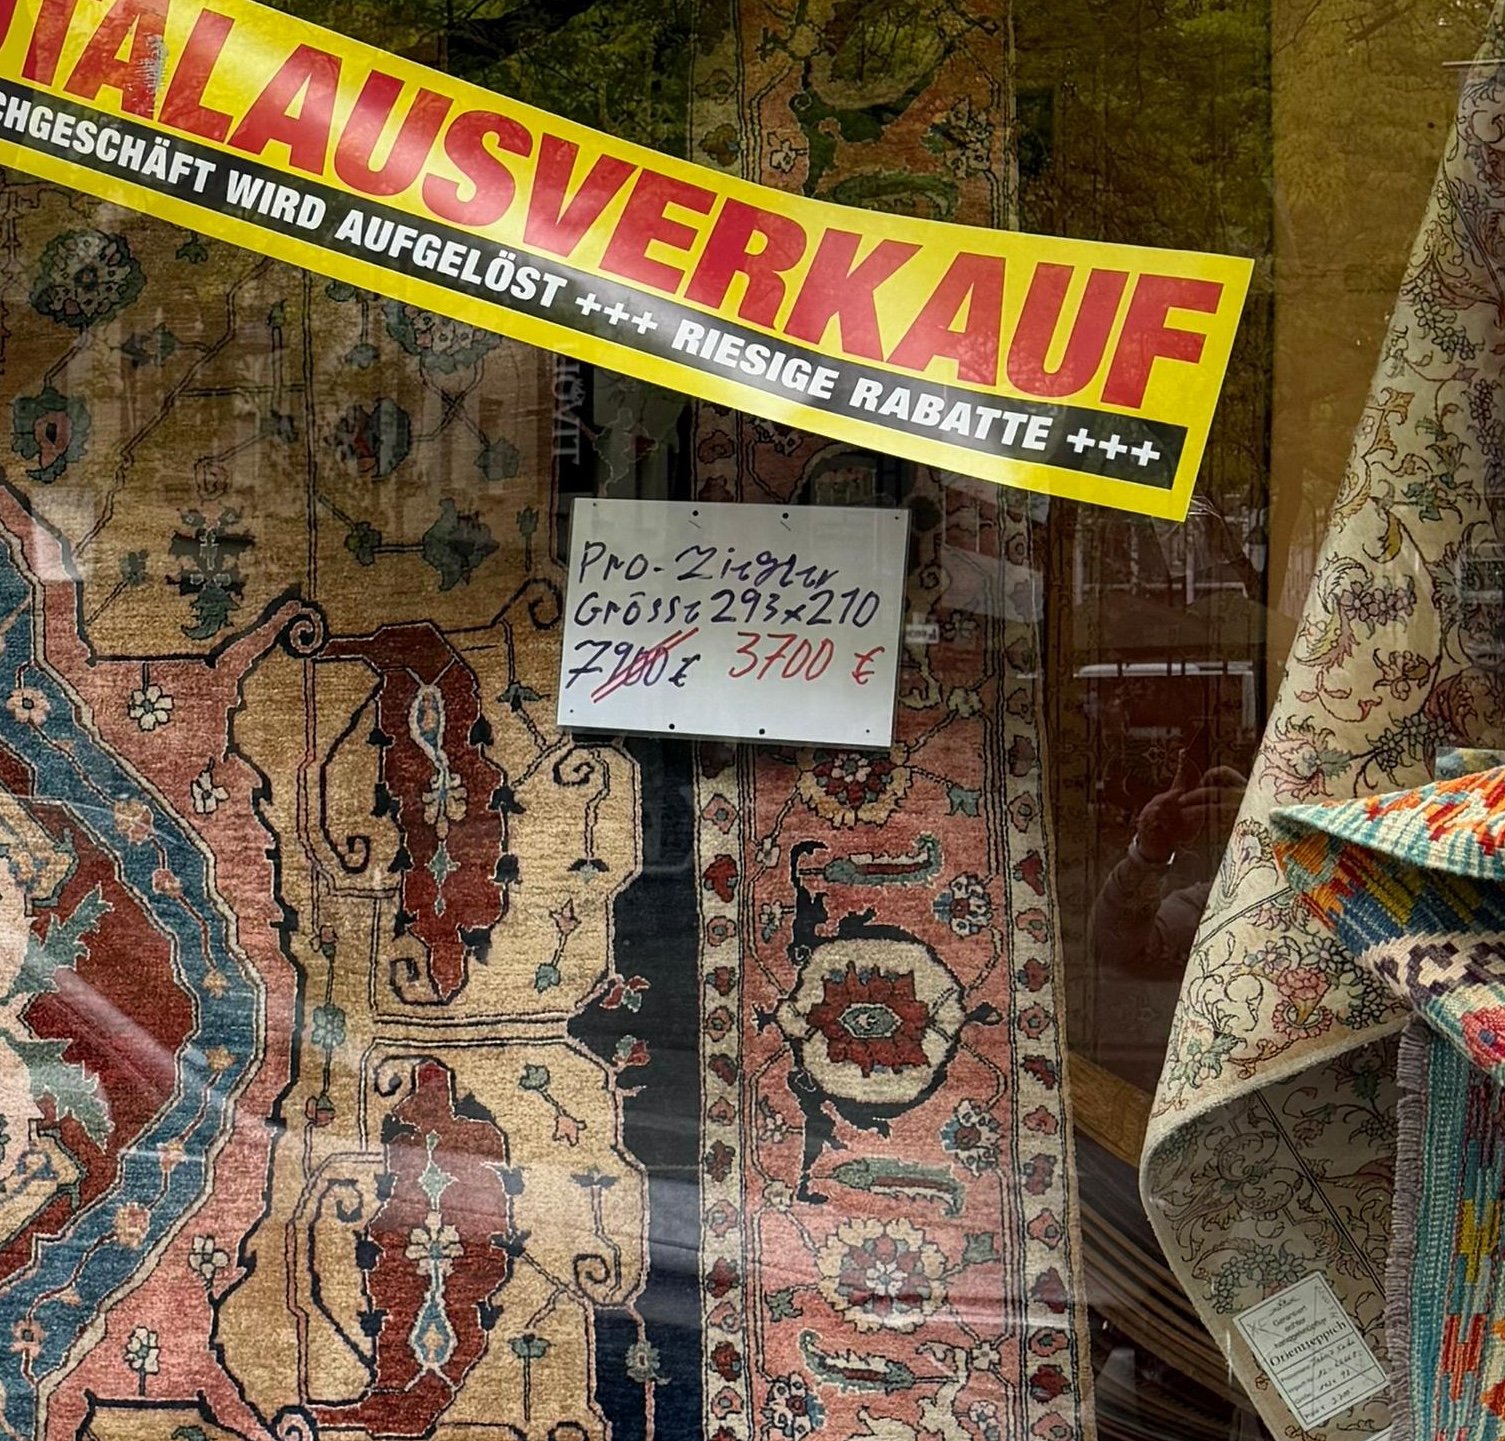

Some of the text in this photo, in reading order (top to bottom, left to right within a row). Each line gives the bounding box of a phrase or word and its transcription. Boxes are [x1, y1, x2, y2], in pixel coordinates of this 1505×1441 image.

[226, 169, 327, 231] WIRD
[334, 209, 569, 308] AUFGELÖST
[672, 317, 840, 401] RIESIGE
[848, 376, 1054, 457] RABATTE
[728, 631, 835, 681] 3700
[1268, 1319, 1348, 1367] Orientteppich
